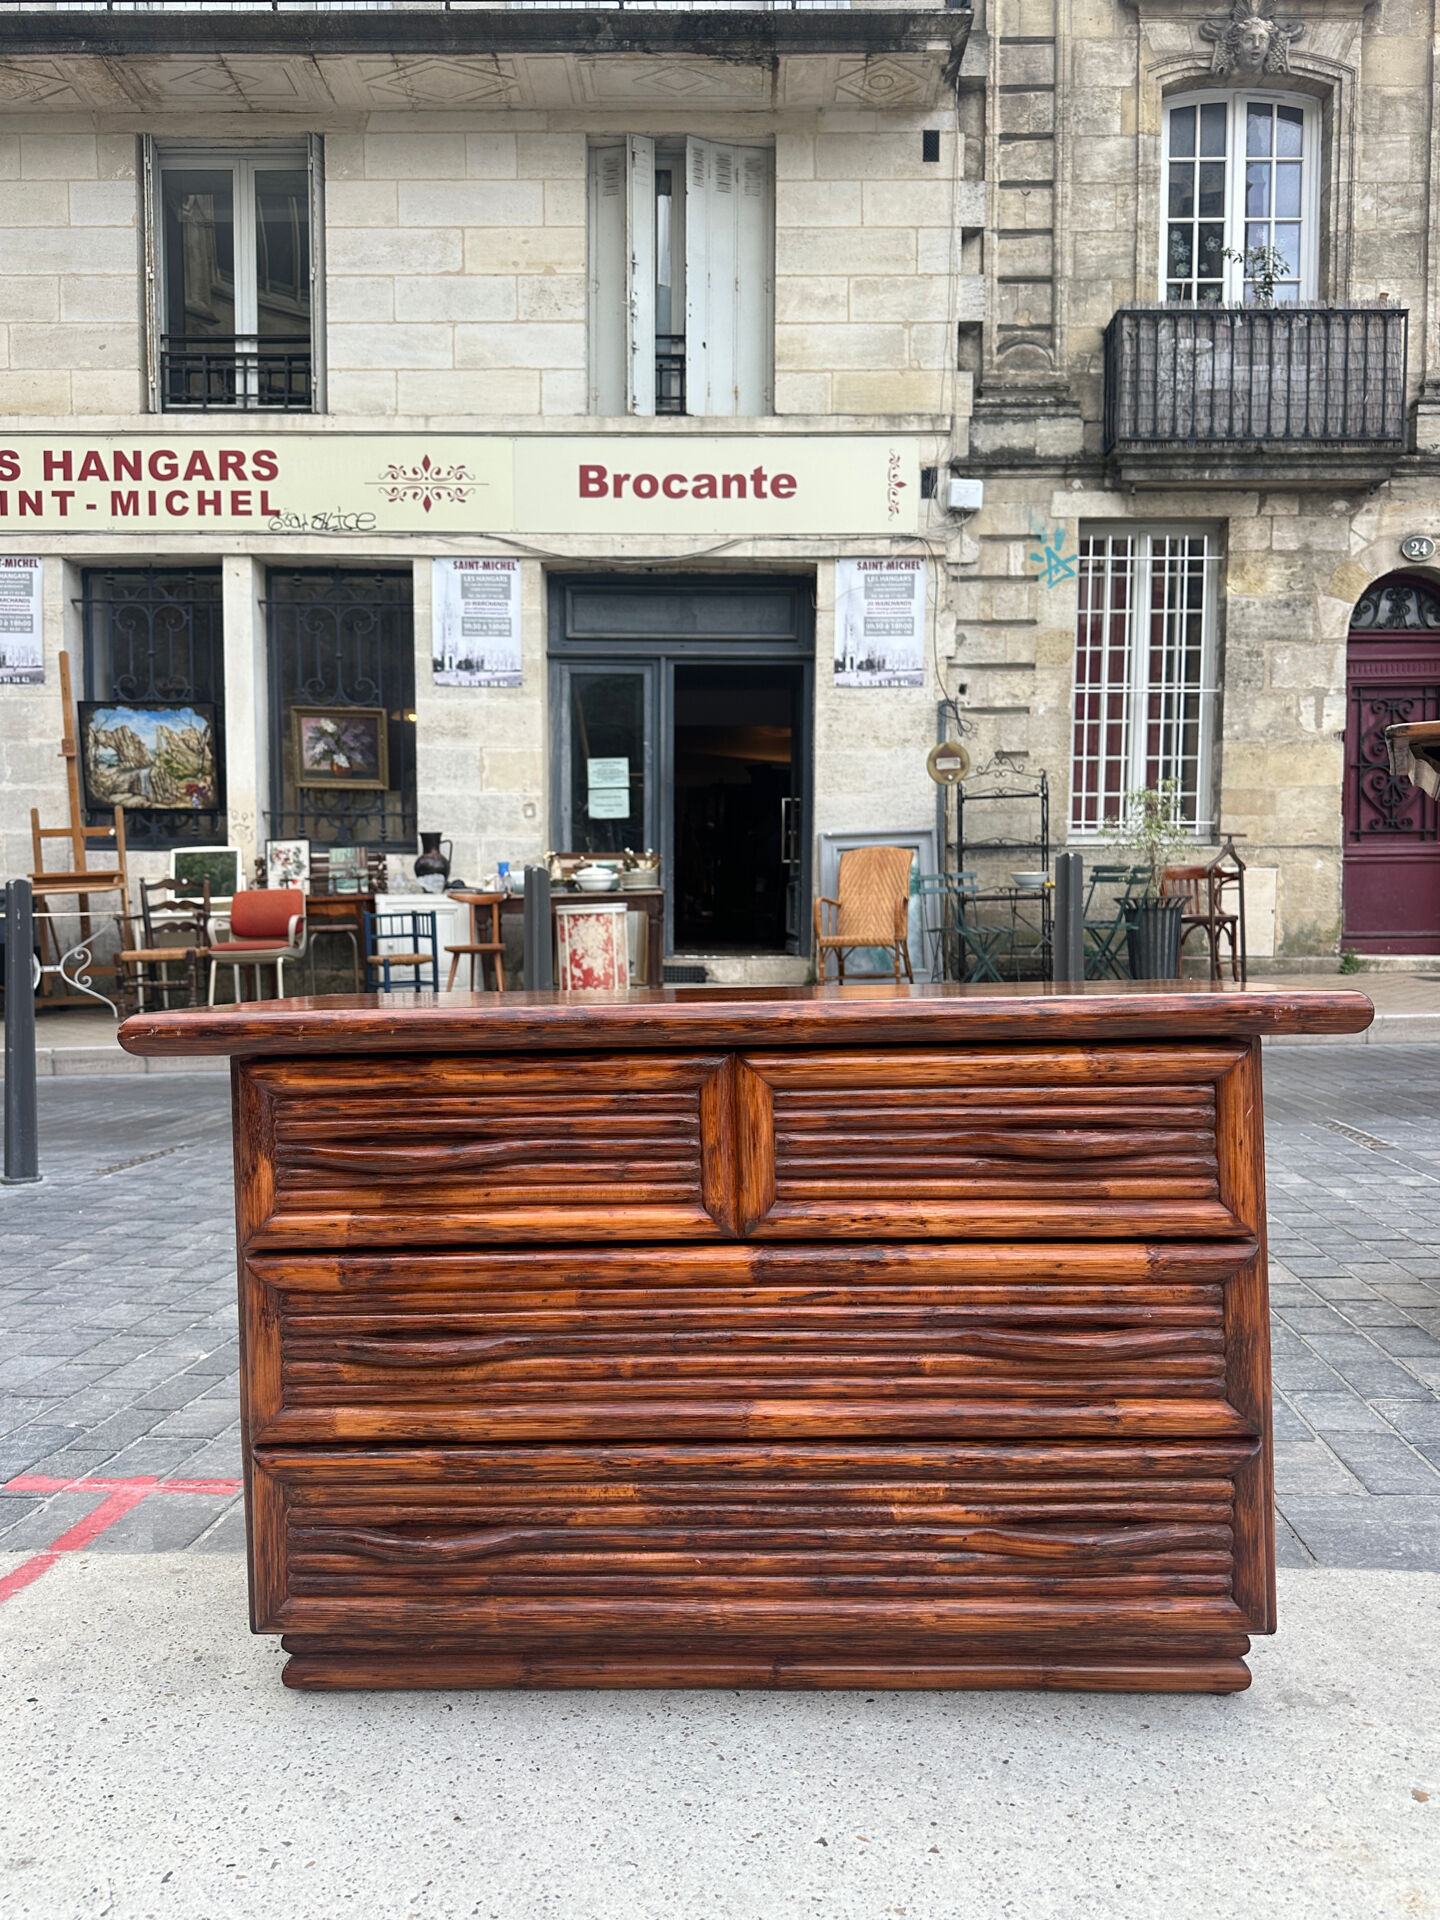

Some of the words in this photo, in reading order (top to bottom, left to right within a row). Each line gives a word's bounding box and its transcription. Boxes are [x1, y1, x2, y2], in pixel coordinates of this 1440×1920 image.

[43, 450, 279, 481] HANGARS
[579, 465, 797, 499] Brocante
[1410, 540, 1428, 556] 24
[453, 561, 516, 571] SAINT-MICHEL
[857, 560, 921, 571] SAINT-MICHEL
